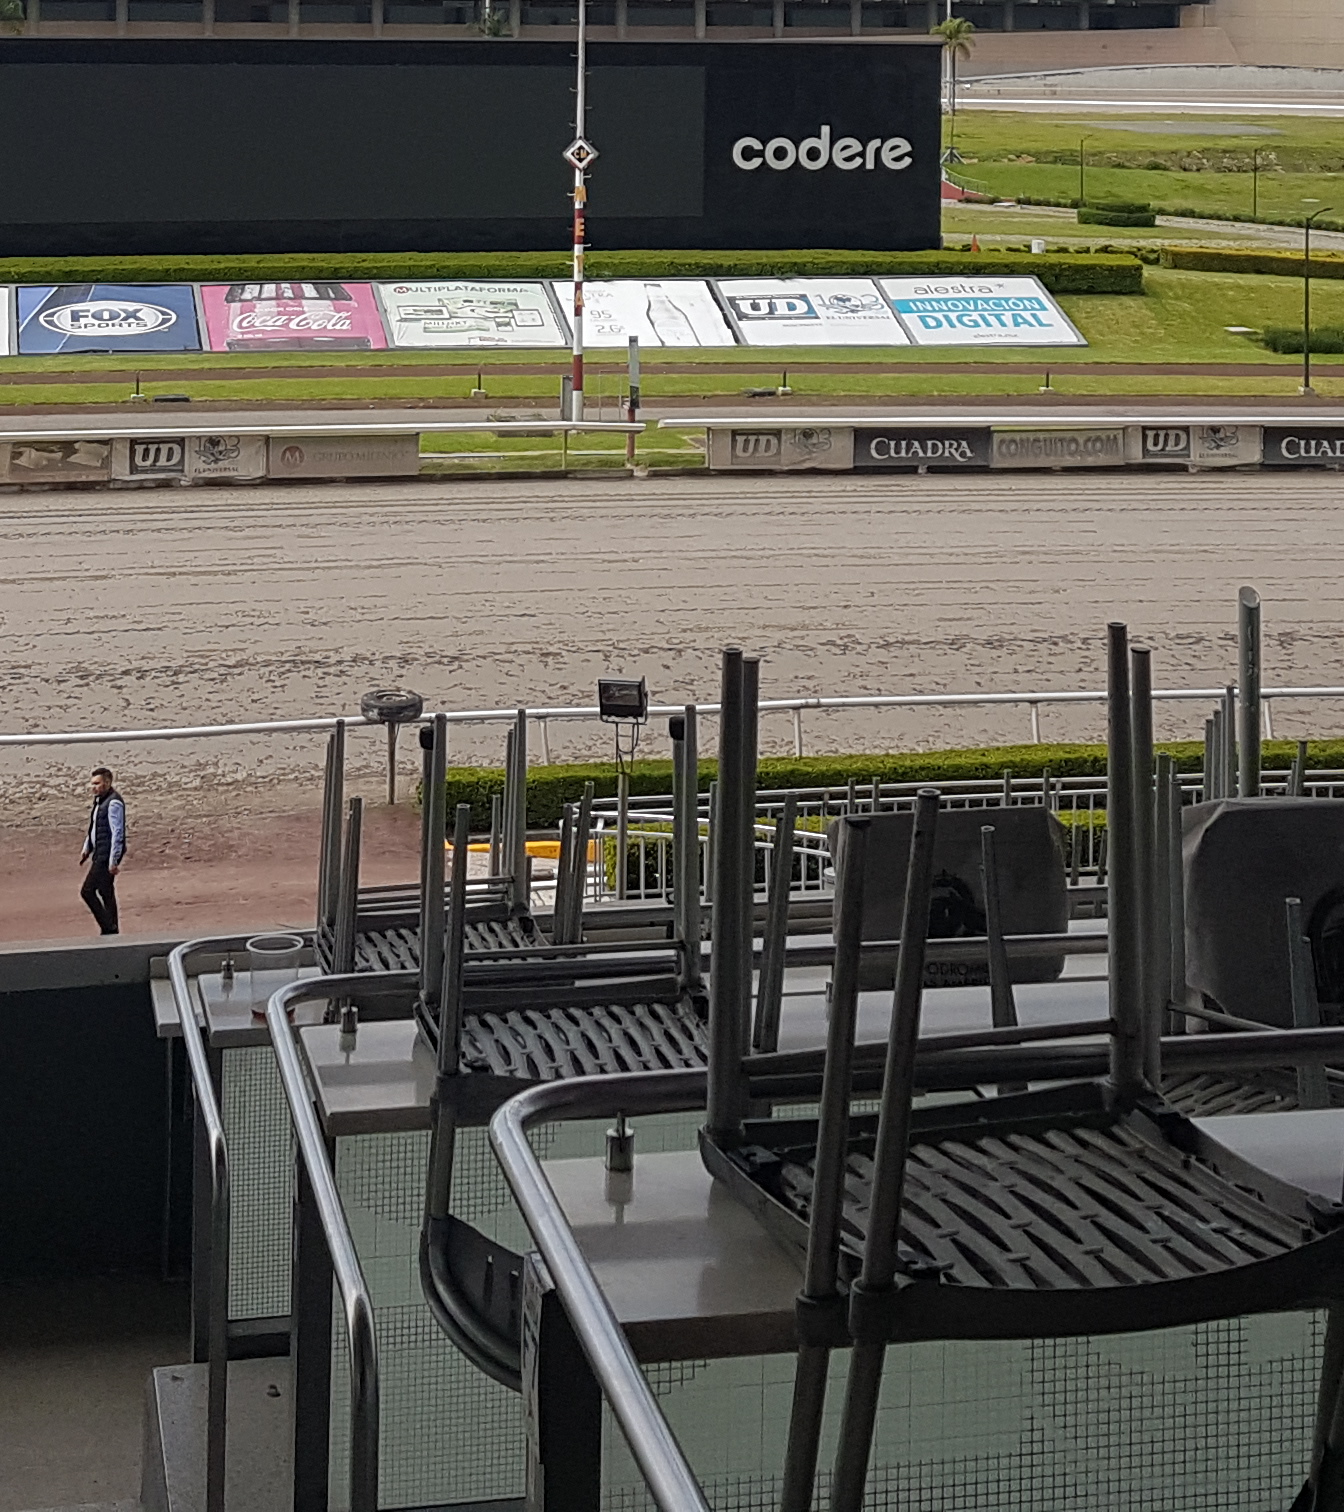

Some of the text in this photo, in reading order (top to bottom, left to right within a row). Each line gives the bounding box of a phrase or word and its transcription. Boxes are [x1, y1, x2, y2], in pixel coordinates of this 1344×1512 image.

[732, 124, 913, 170] codere
[914, 284, 994, 296] alestra
[735, 297, 809, 316] UD
[909, 298, 1041, 312] INNOVACIÓN
[70, 308, 145, 323] FOX
[232, 310, 352, 332] Coca-Cola
[917, 313, 1054, 330] DIGITAL
[70, 322, 148, 330] SPORTS
[735, 434, 780, 458] UD
[870, 437, 973, 462] CUADRA
[1145, 429, 1188, 452] UD
[134, 442, 183, 468] UD
